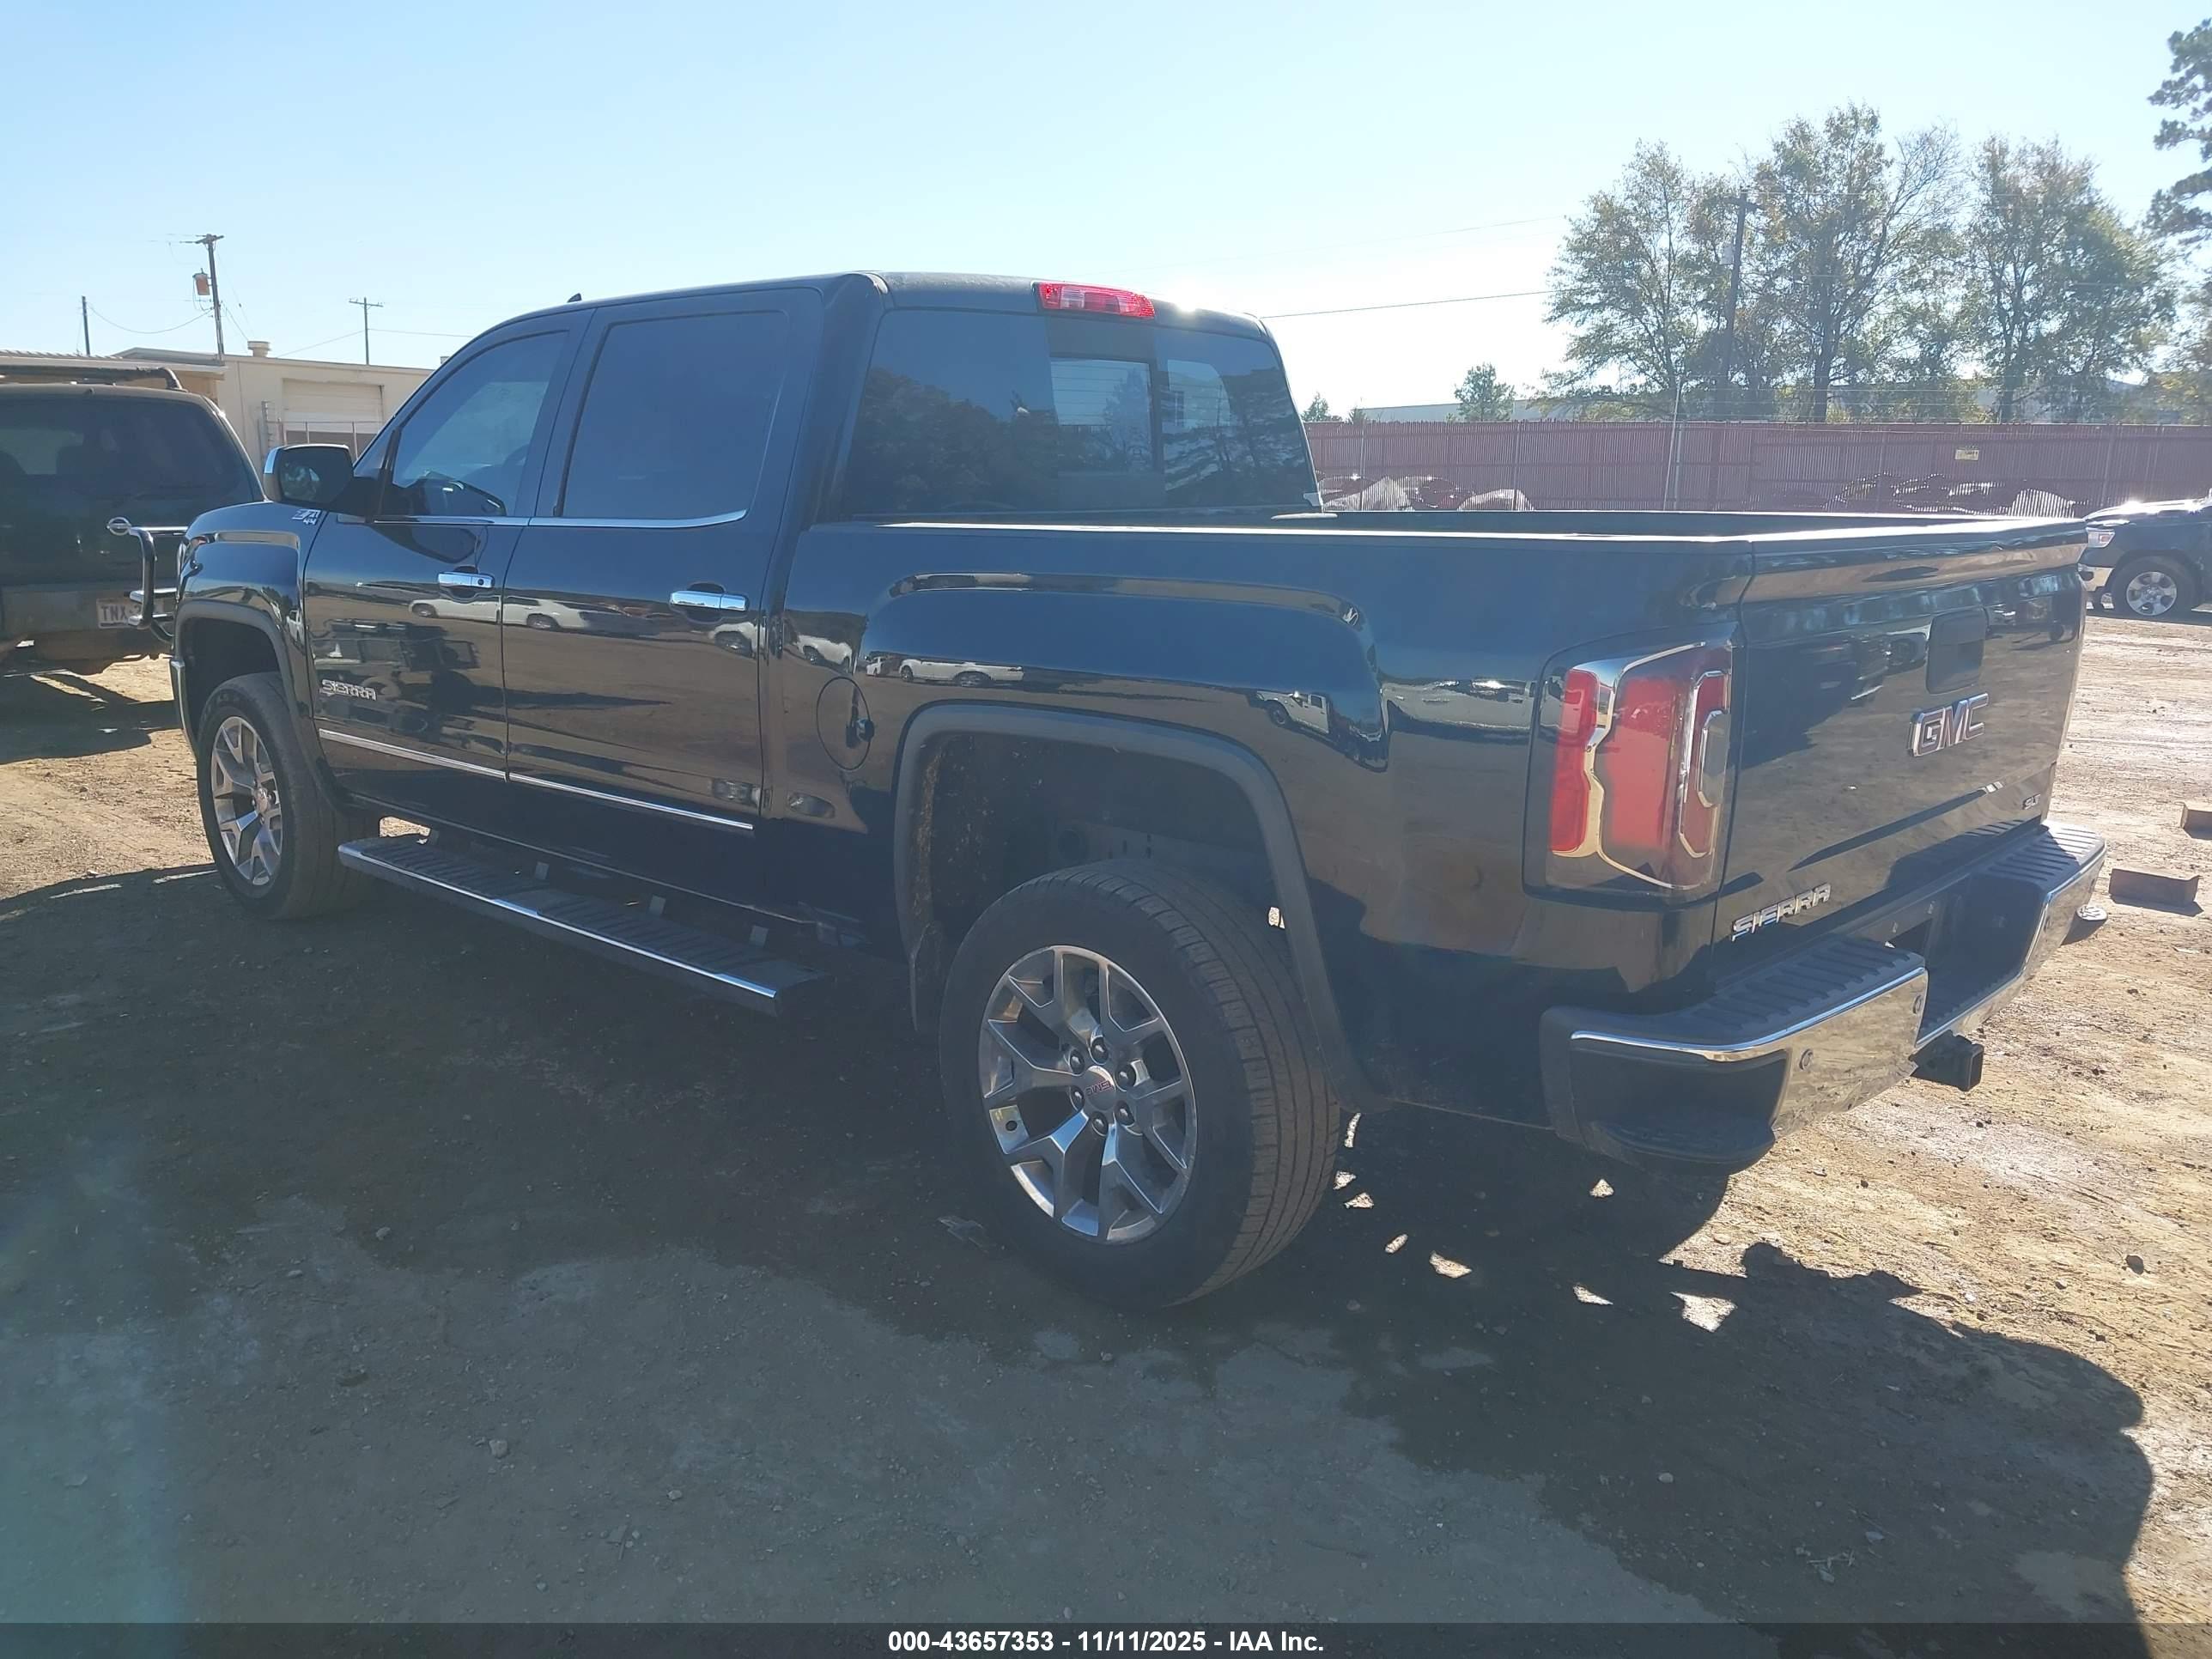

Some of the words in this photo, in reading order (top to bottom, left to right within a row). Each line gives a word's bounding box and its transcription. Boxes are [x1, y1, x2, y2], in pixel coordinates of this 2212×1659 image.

[320, 678, 377, 702] SIERRA
[1910, 691, 1990, 757] GMC
[1731, 882, 1832, 942] SIERRA
[1084, 1079, 1112, 1097] GMC
